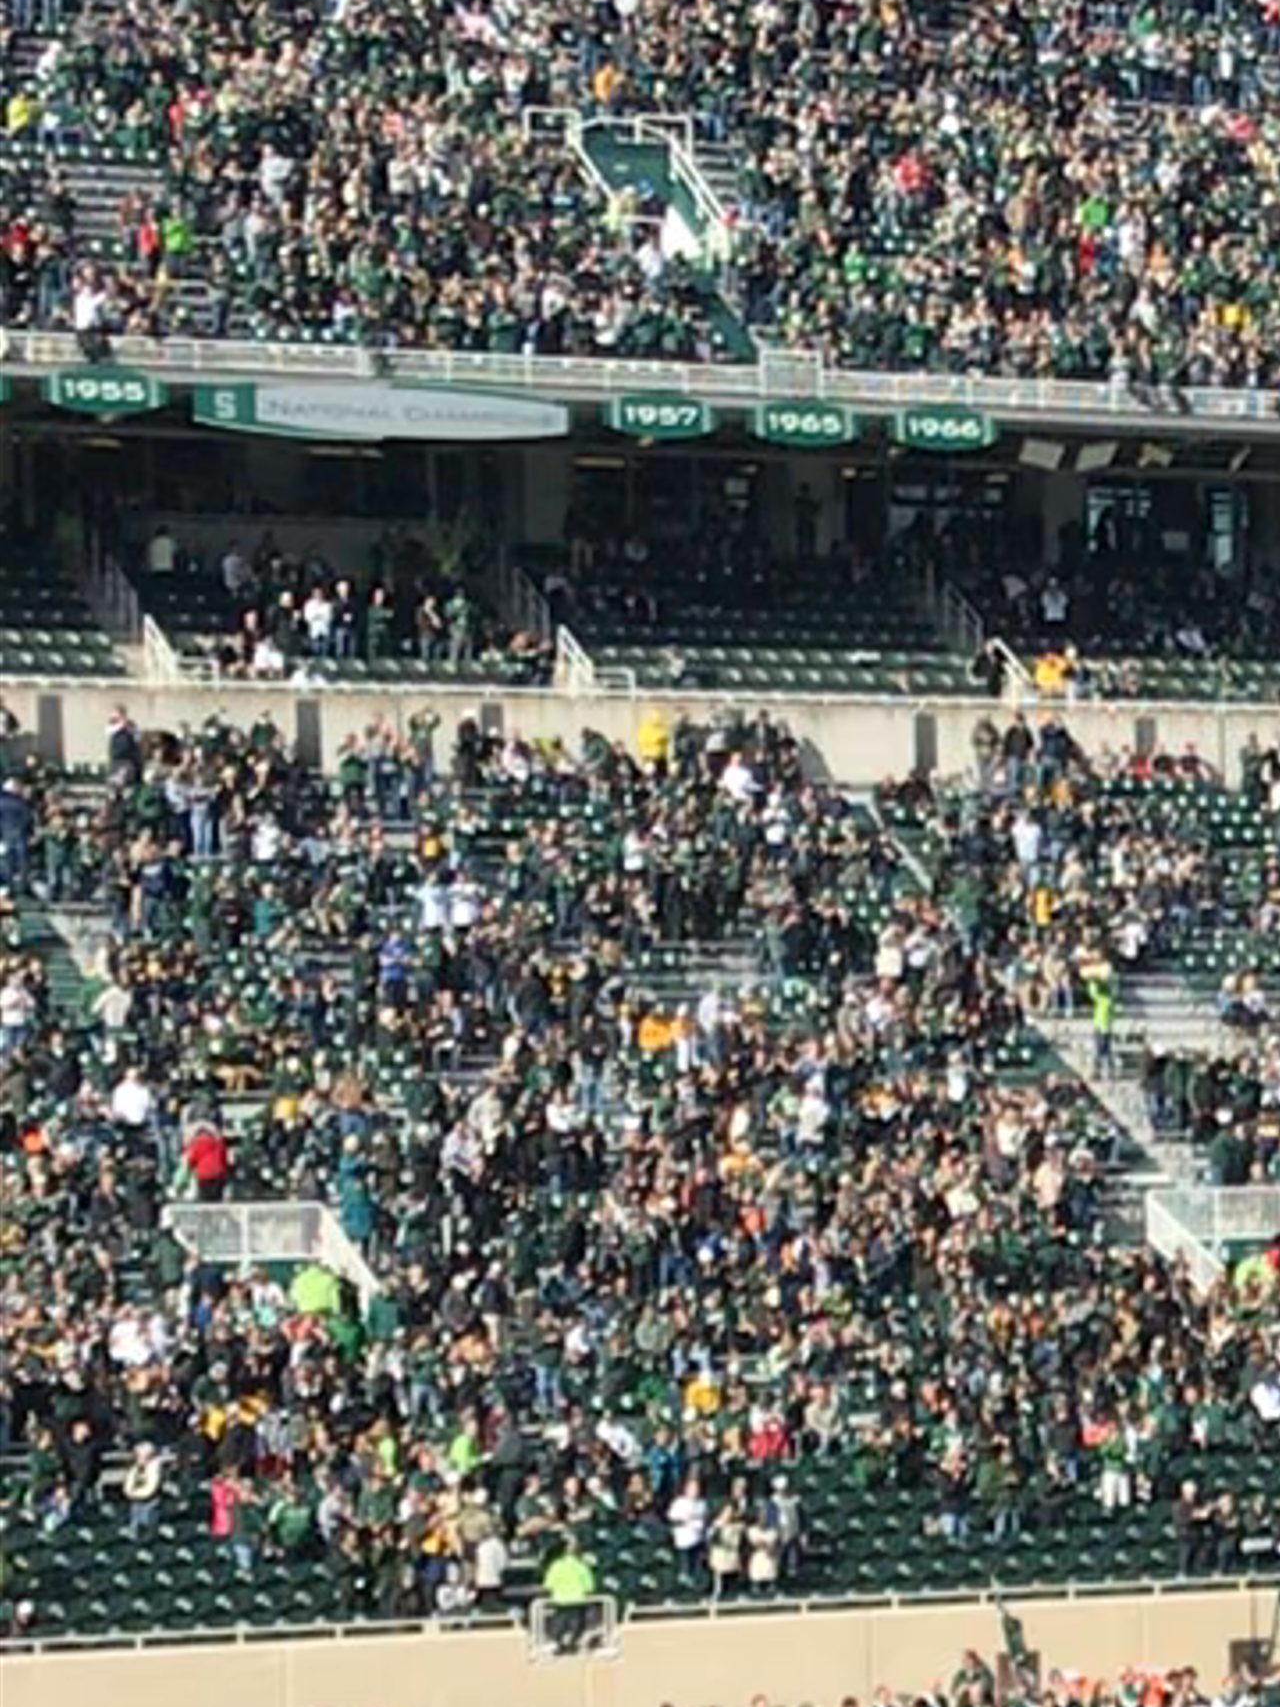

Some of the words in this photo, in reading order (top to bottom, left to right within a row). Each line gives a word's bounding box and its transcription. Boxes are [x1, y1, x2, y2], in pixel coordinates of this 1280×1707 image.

[64, 378, 146, 402] 1955
[214, 391, 237, 420] S
[624, 404, 698, 427] 1957
[769, 412, 842, 435] 1965
[908, 418, 981, 440] 1966
